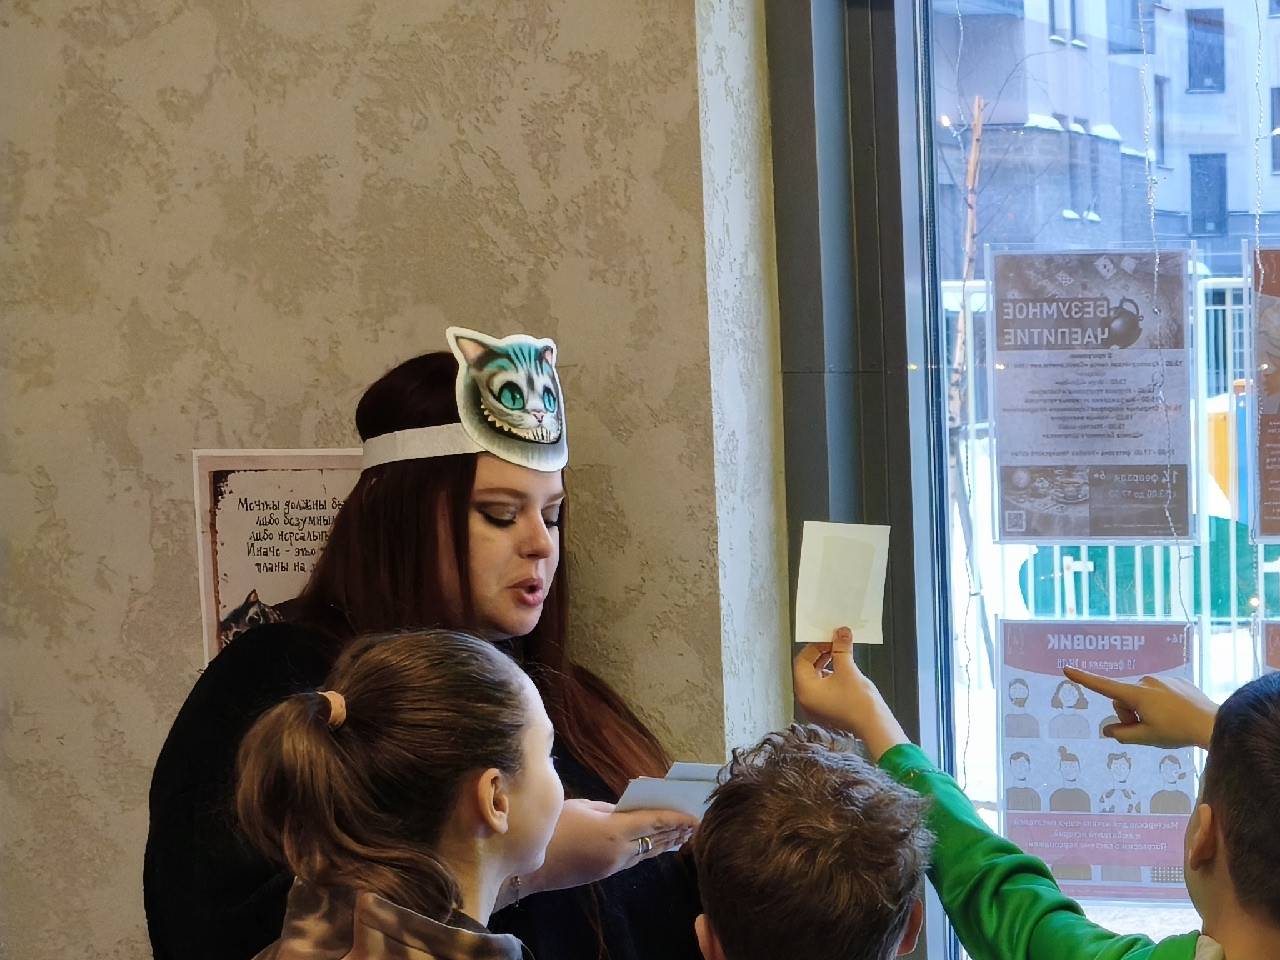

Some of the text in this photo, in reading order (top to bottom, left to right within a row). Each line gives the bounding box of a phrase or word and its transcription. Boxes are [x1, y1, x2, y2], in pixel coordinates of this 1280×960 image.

[238, 498, 280, 511] Мечты
[283, 500, 327, 515] должны
[256, 513, 280, 527] либо
[249, 529, 274, 542] либо
[247, 542, 281, 557] Иначе
[295, 548, 316, 557] это
[255, 562, 289, 573] планы
[294, 562, 306, 573] на
